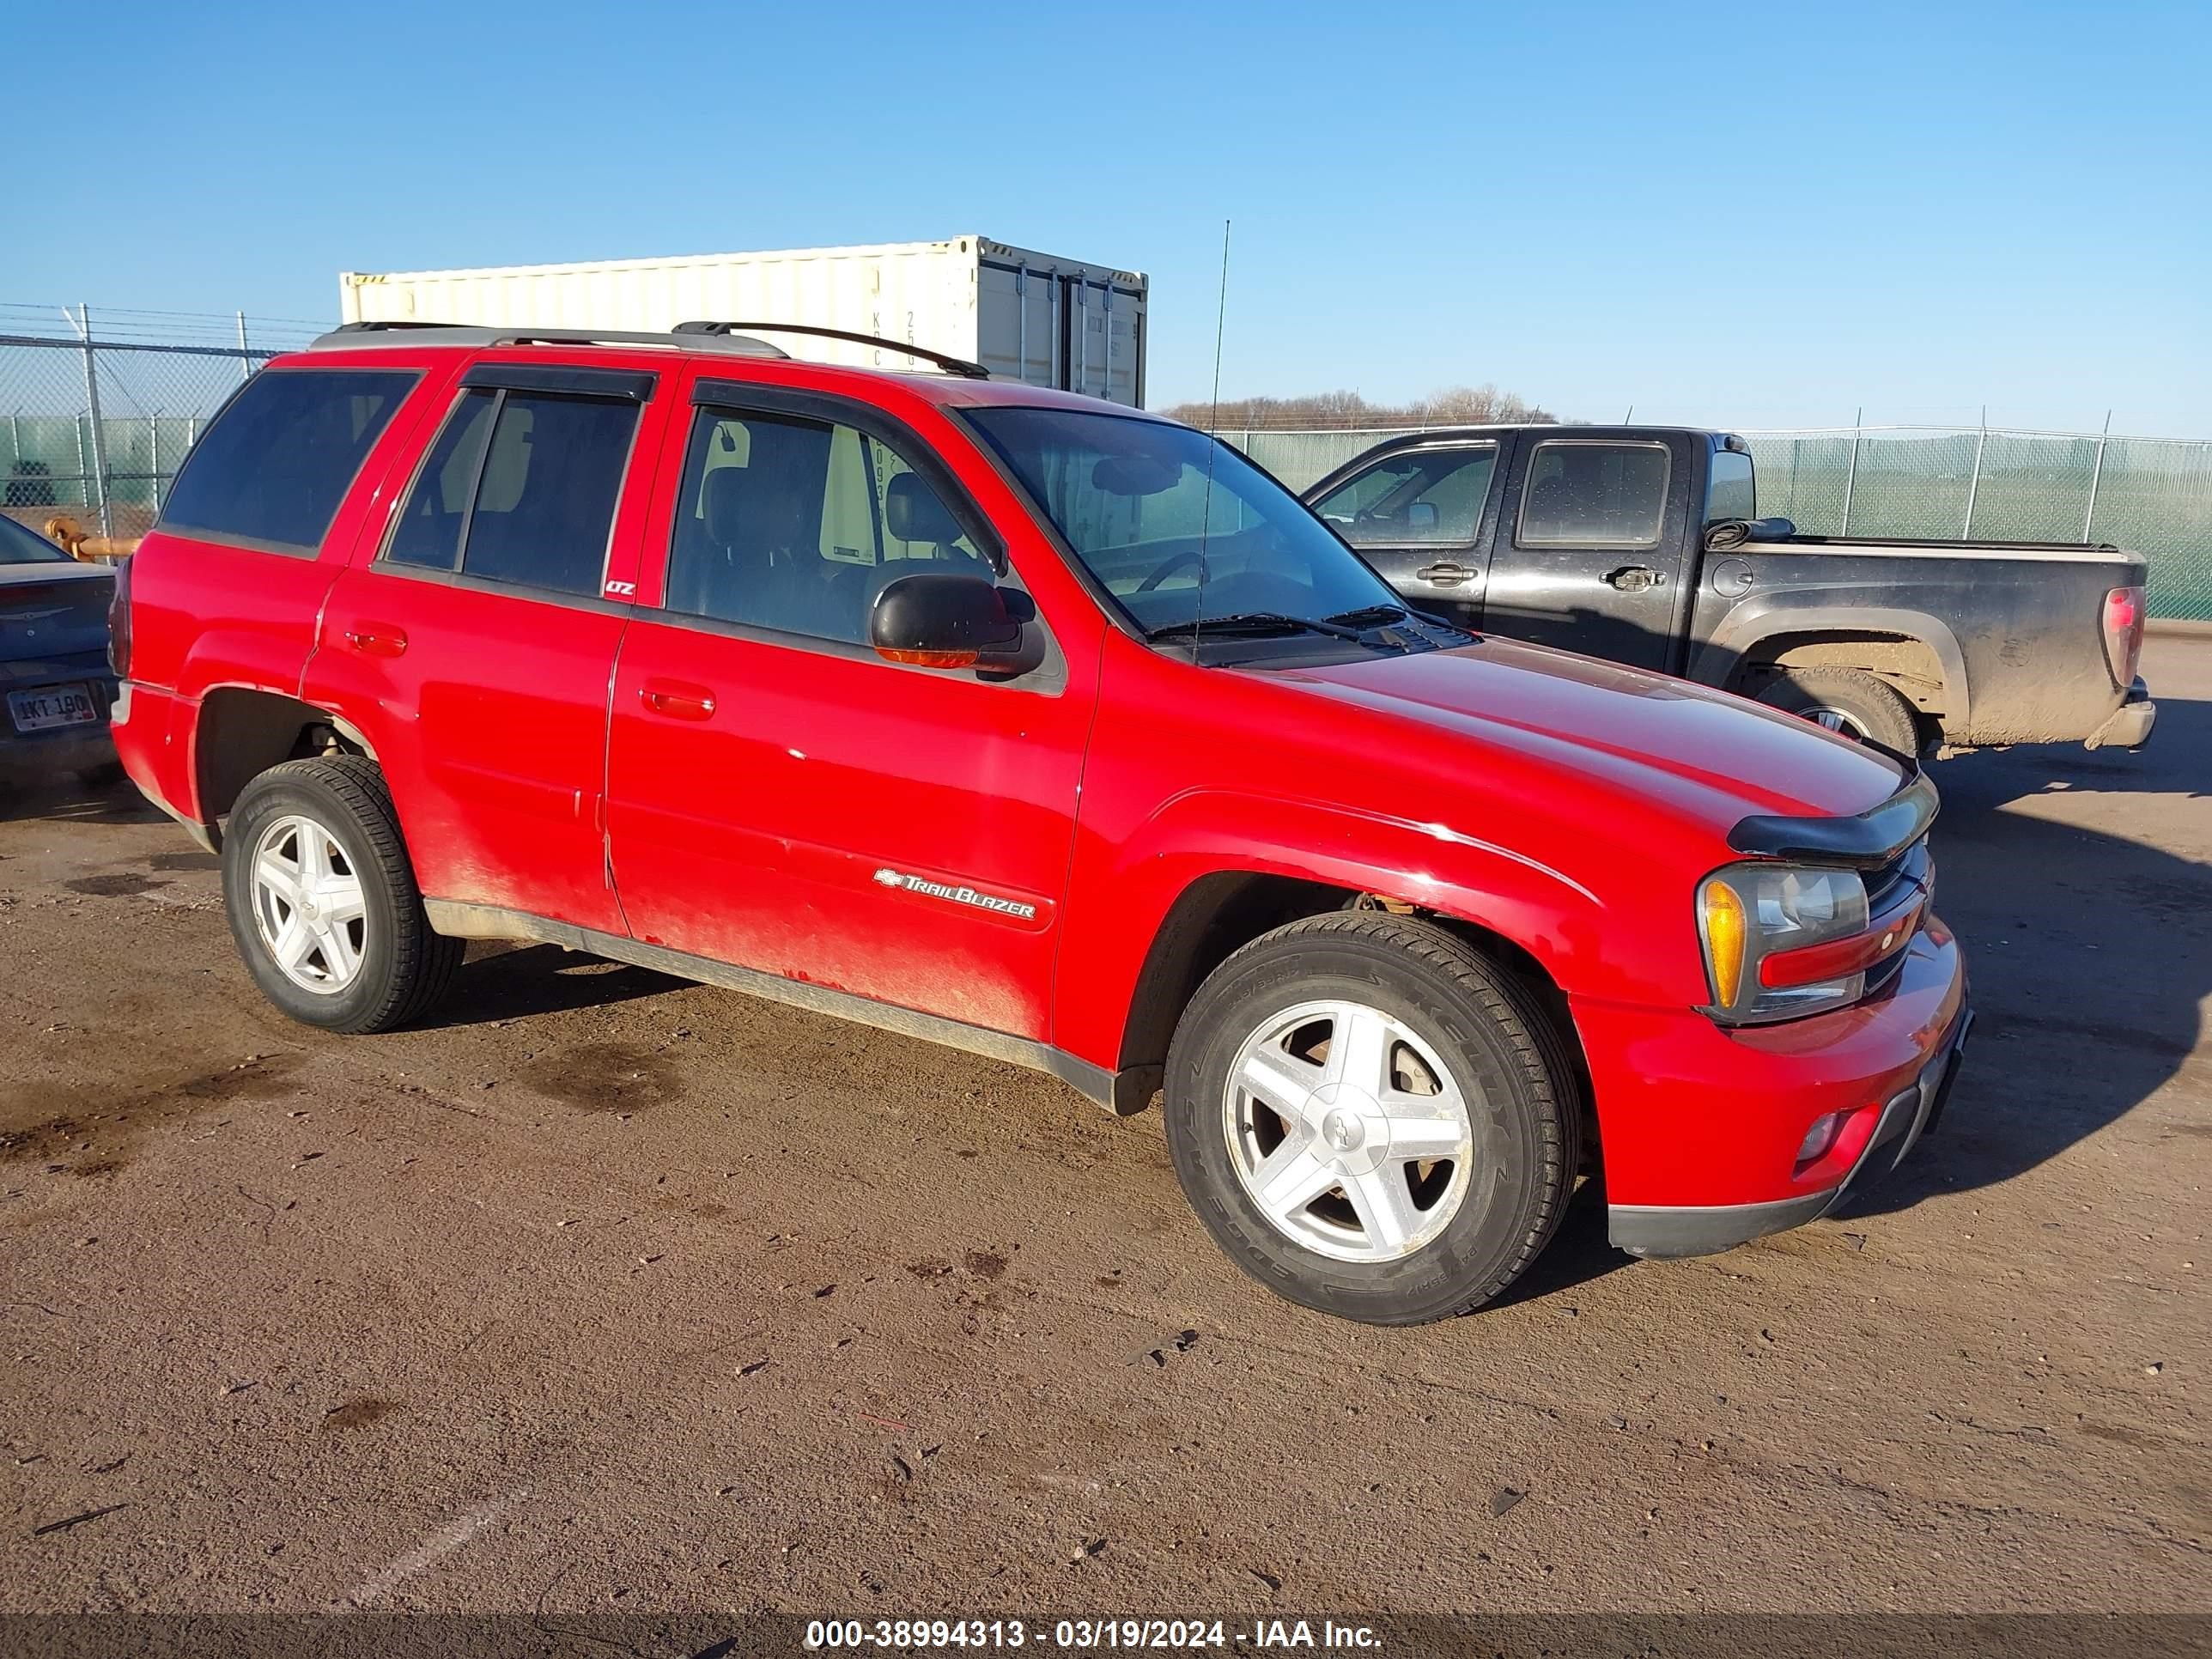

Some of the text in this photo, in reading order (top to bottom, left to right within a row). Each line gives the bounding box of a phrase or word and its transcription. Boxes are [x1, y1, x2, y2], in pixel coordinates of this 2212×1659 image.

[605, 580, 636, 596] LTZ
[20, 698, 49, 720] 1KT
[1404, 988, 1513, 1141] KELLY
[1207, 1196, 1300, 1284] EDGE
